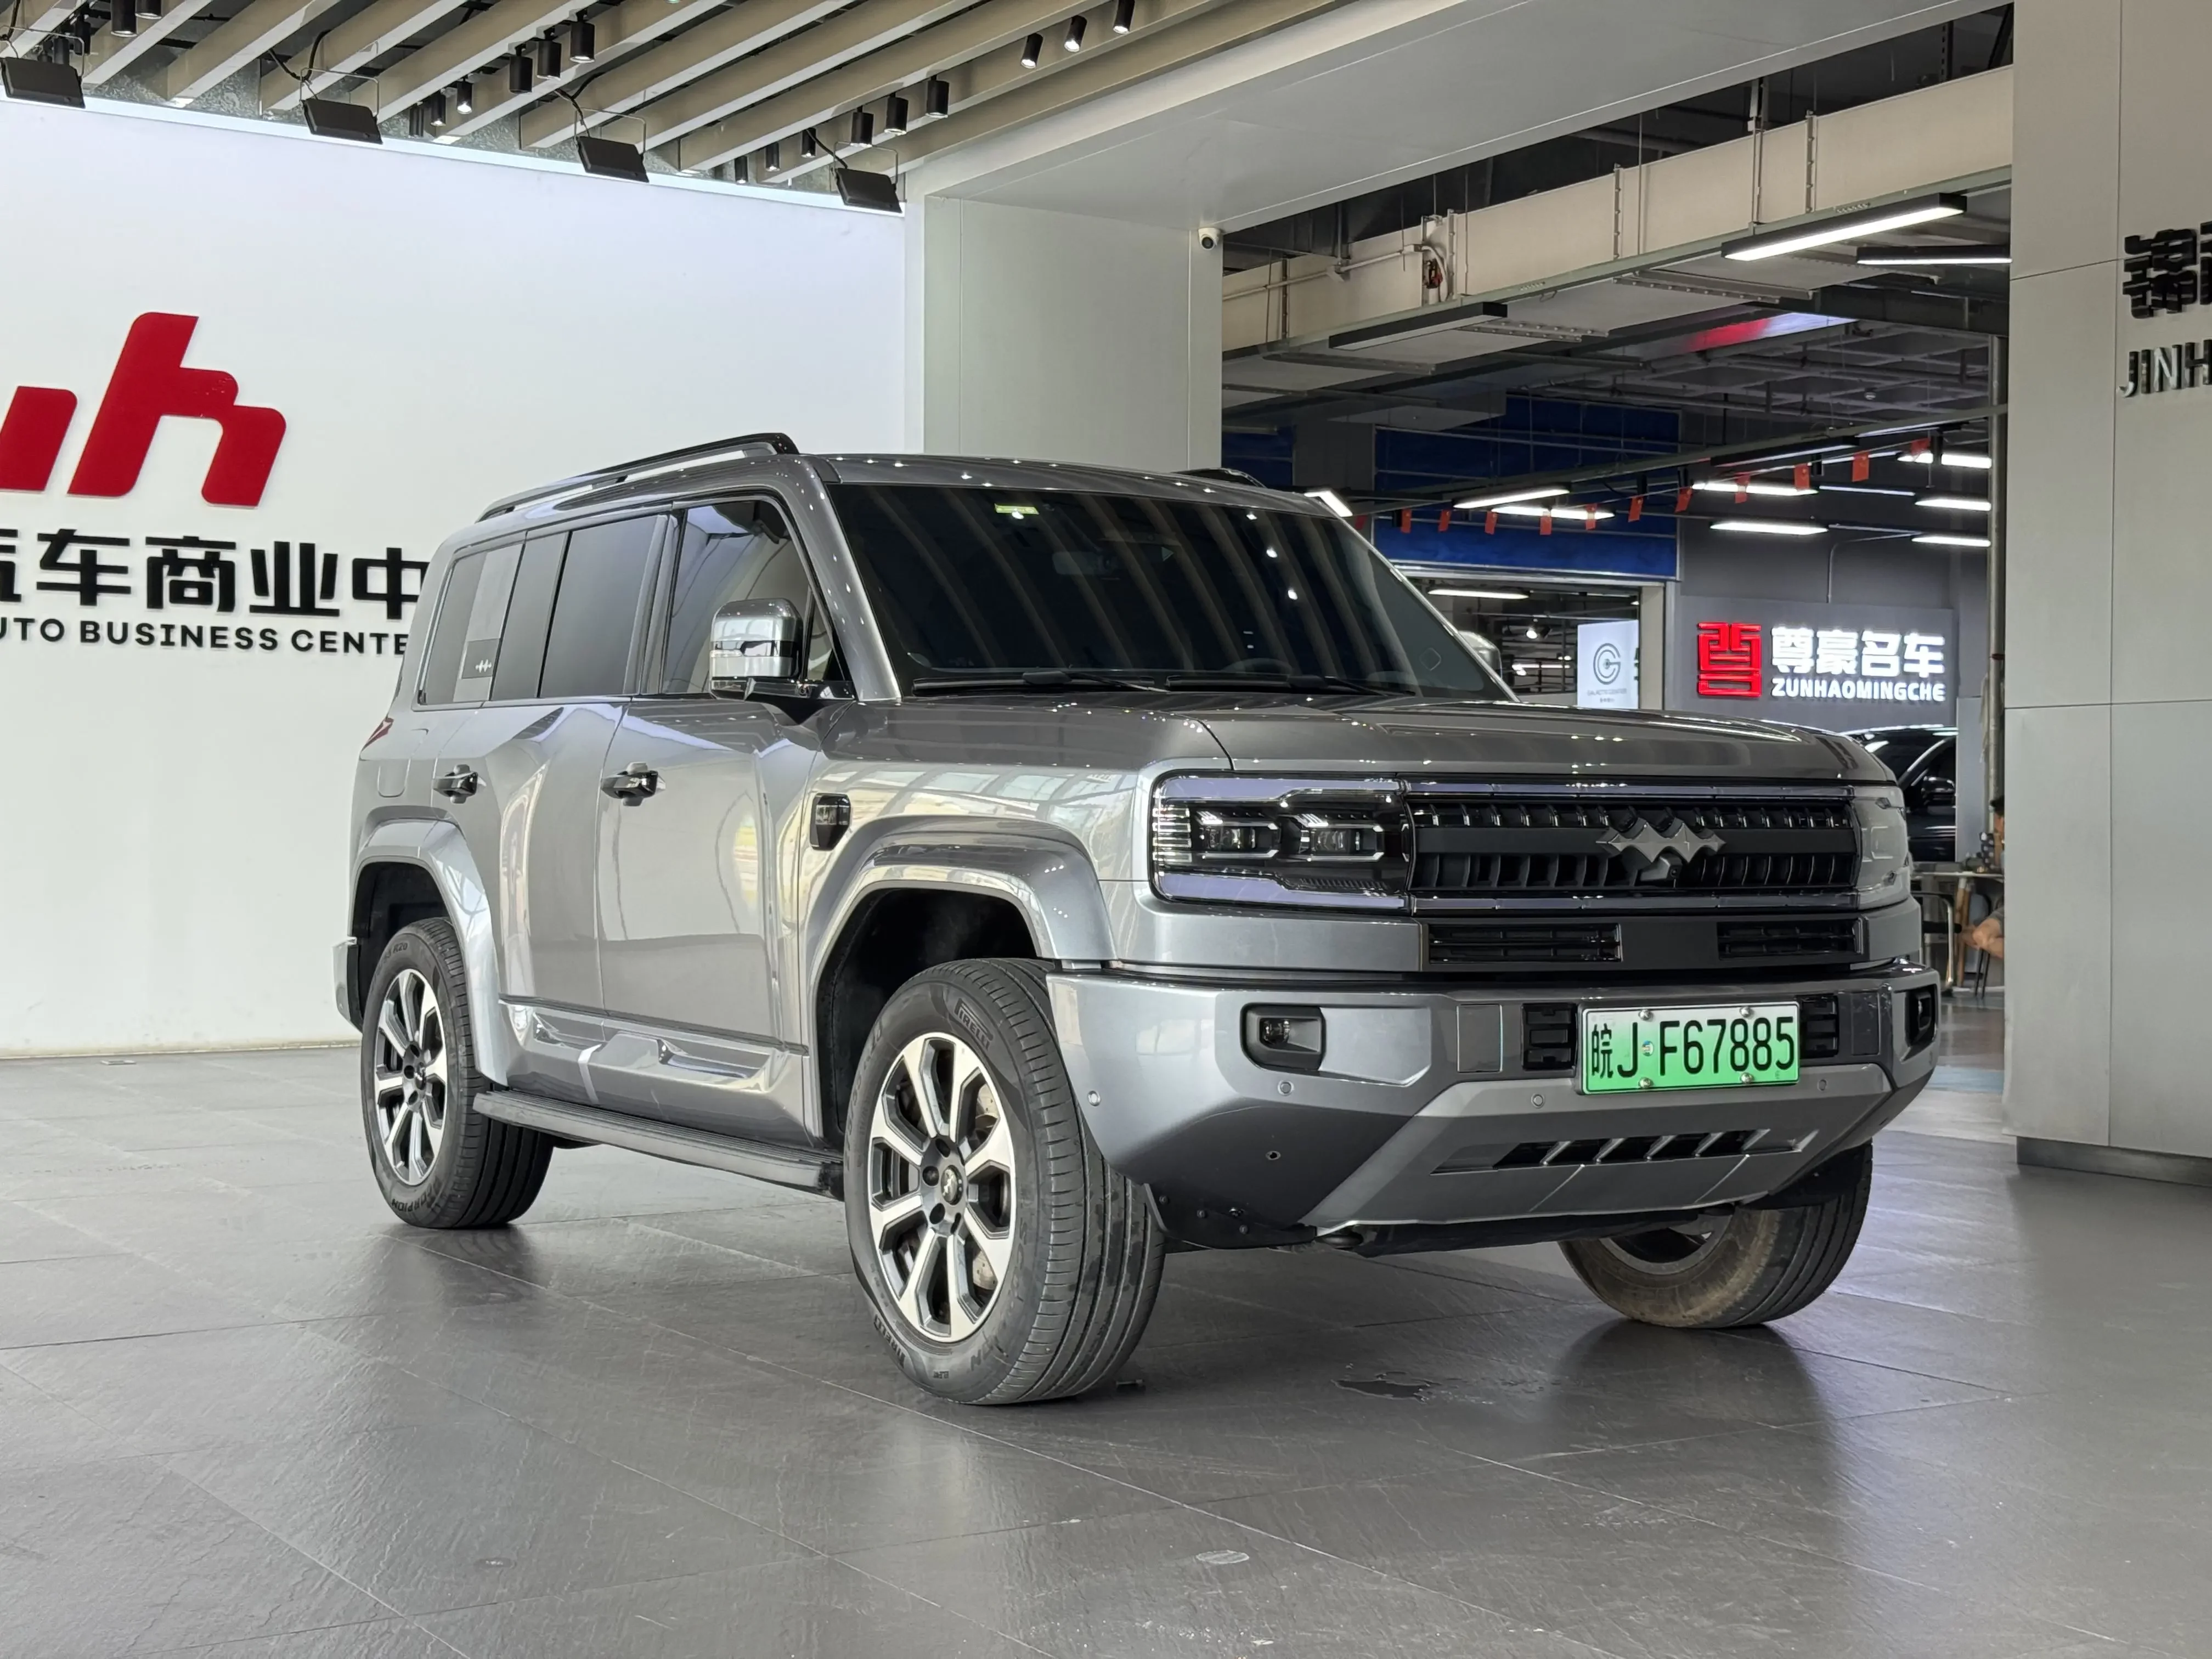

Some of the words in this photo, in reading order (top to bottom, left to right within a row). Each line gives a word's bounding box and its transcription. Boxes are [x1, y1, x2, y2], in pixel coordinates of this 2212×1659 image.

[80, 620, 279, 651] BUSINESS
[1771, 626, 1946, 679] 尊豪名车
[1771, 678, 1946, 702] ZUNHAOMINGCHE
[954, 997, 994, 1051] PIRELLI
